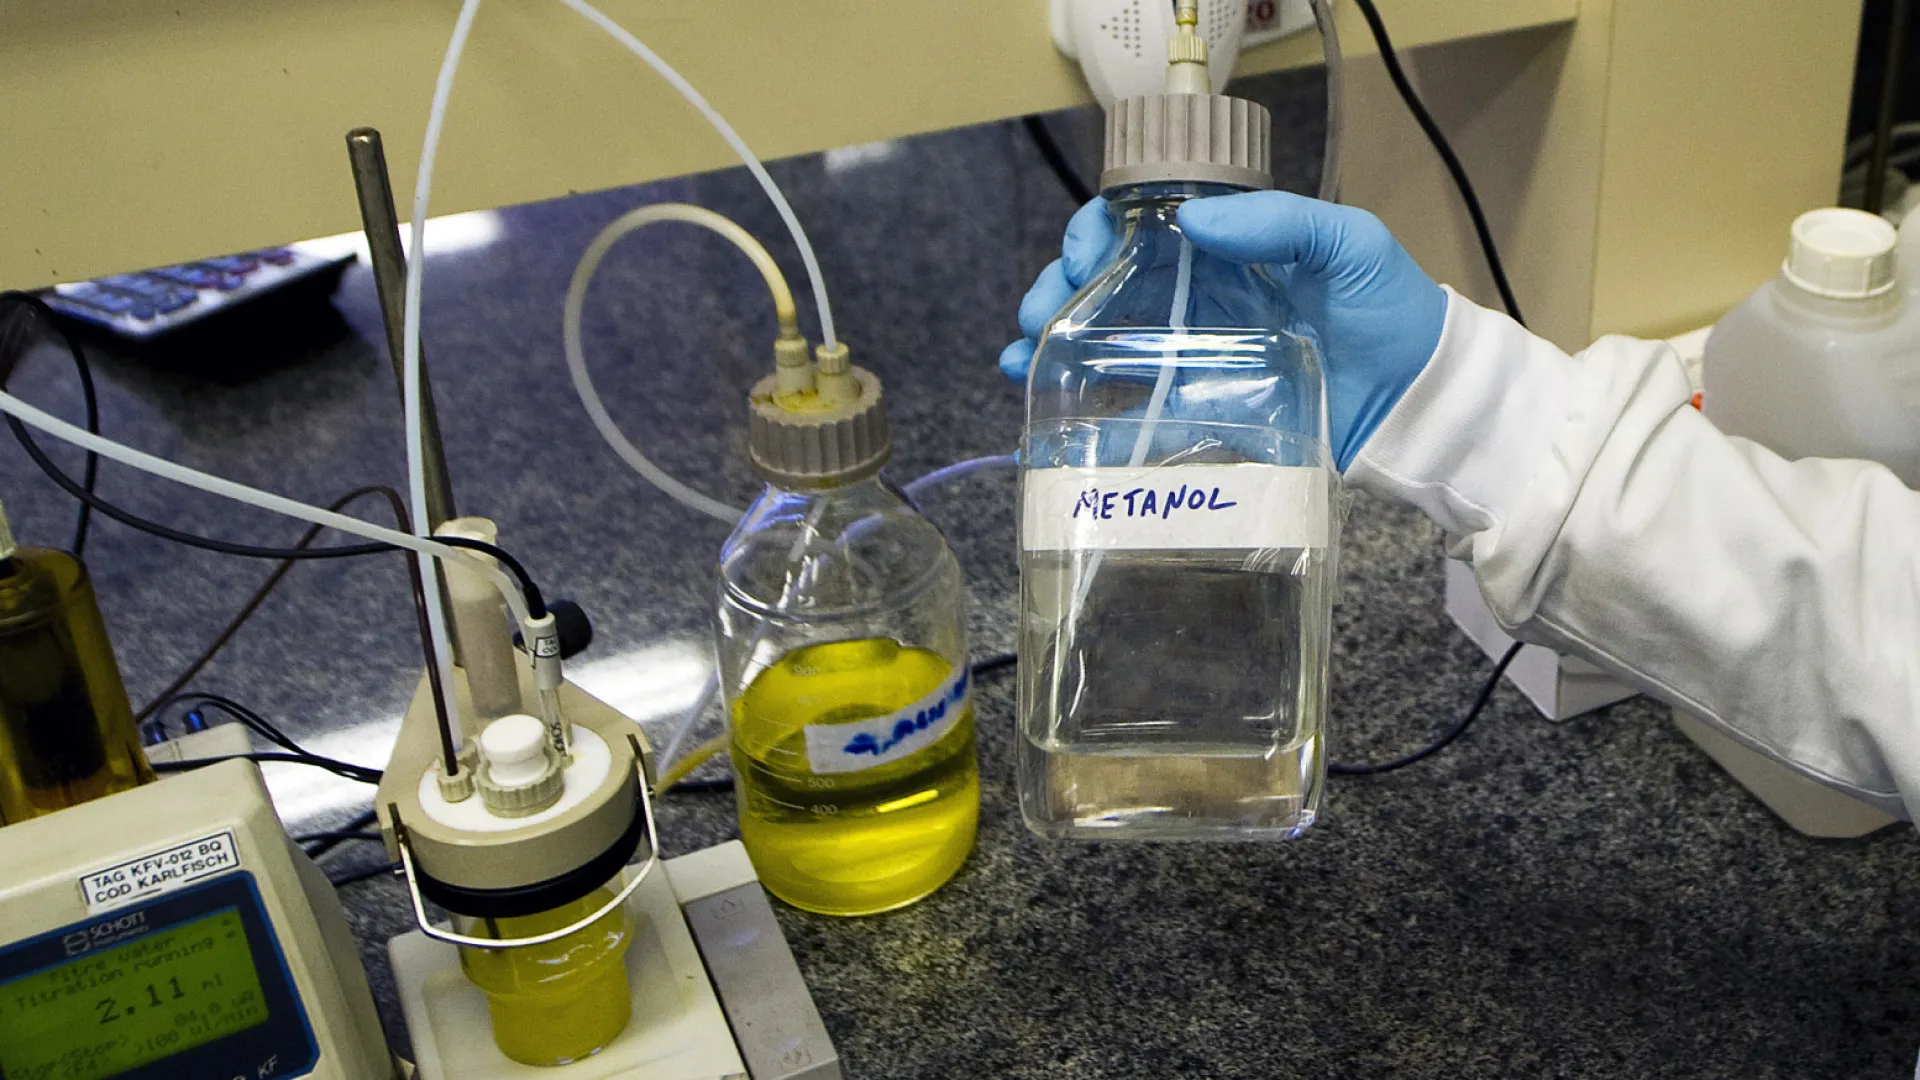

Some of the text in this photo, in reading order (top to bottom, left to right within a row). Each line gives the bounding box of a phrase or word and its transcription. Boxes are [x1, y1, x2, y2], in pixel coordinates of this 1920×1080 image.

[1072, 484, 1238, 520] METANOL
[811, 804, 837, 815] 400
[93, 841, 222, 888] TAG KFV-012 BQ
[95, 853, 229, 903] COD KARLFISCH
[90, 911, 146, 938] SCHOTT
[16, 936, 214, 1011] Titration running
[95, 976, 184, 1024] 2.11
